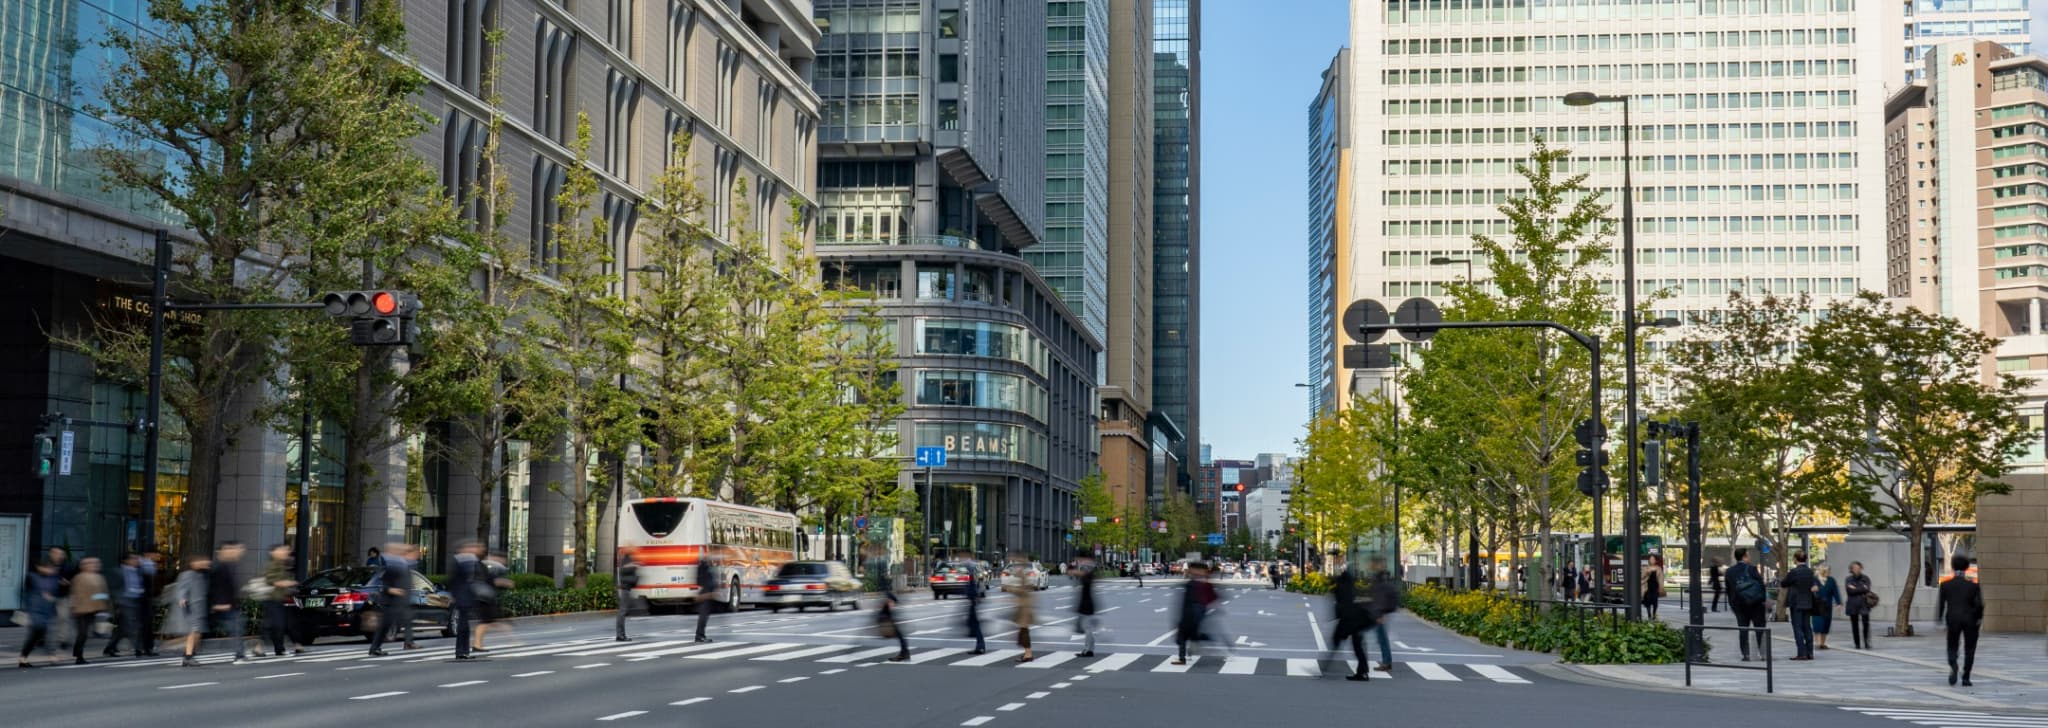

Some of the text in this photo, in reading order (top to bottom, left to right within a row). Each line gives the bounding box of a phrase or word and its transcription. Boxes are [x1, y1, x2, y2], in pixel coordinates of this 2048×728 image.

[113, 296, 133, 311] THE
[135, 301, 177, 320] COAN
[944, 435, 1008, 454] BEAMS
